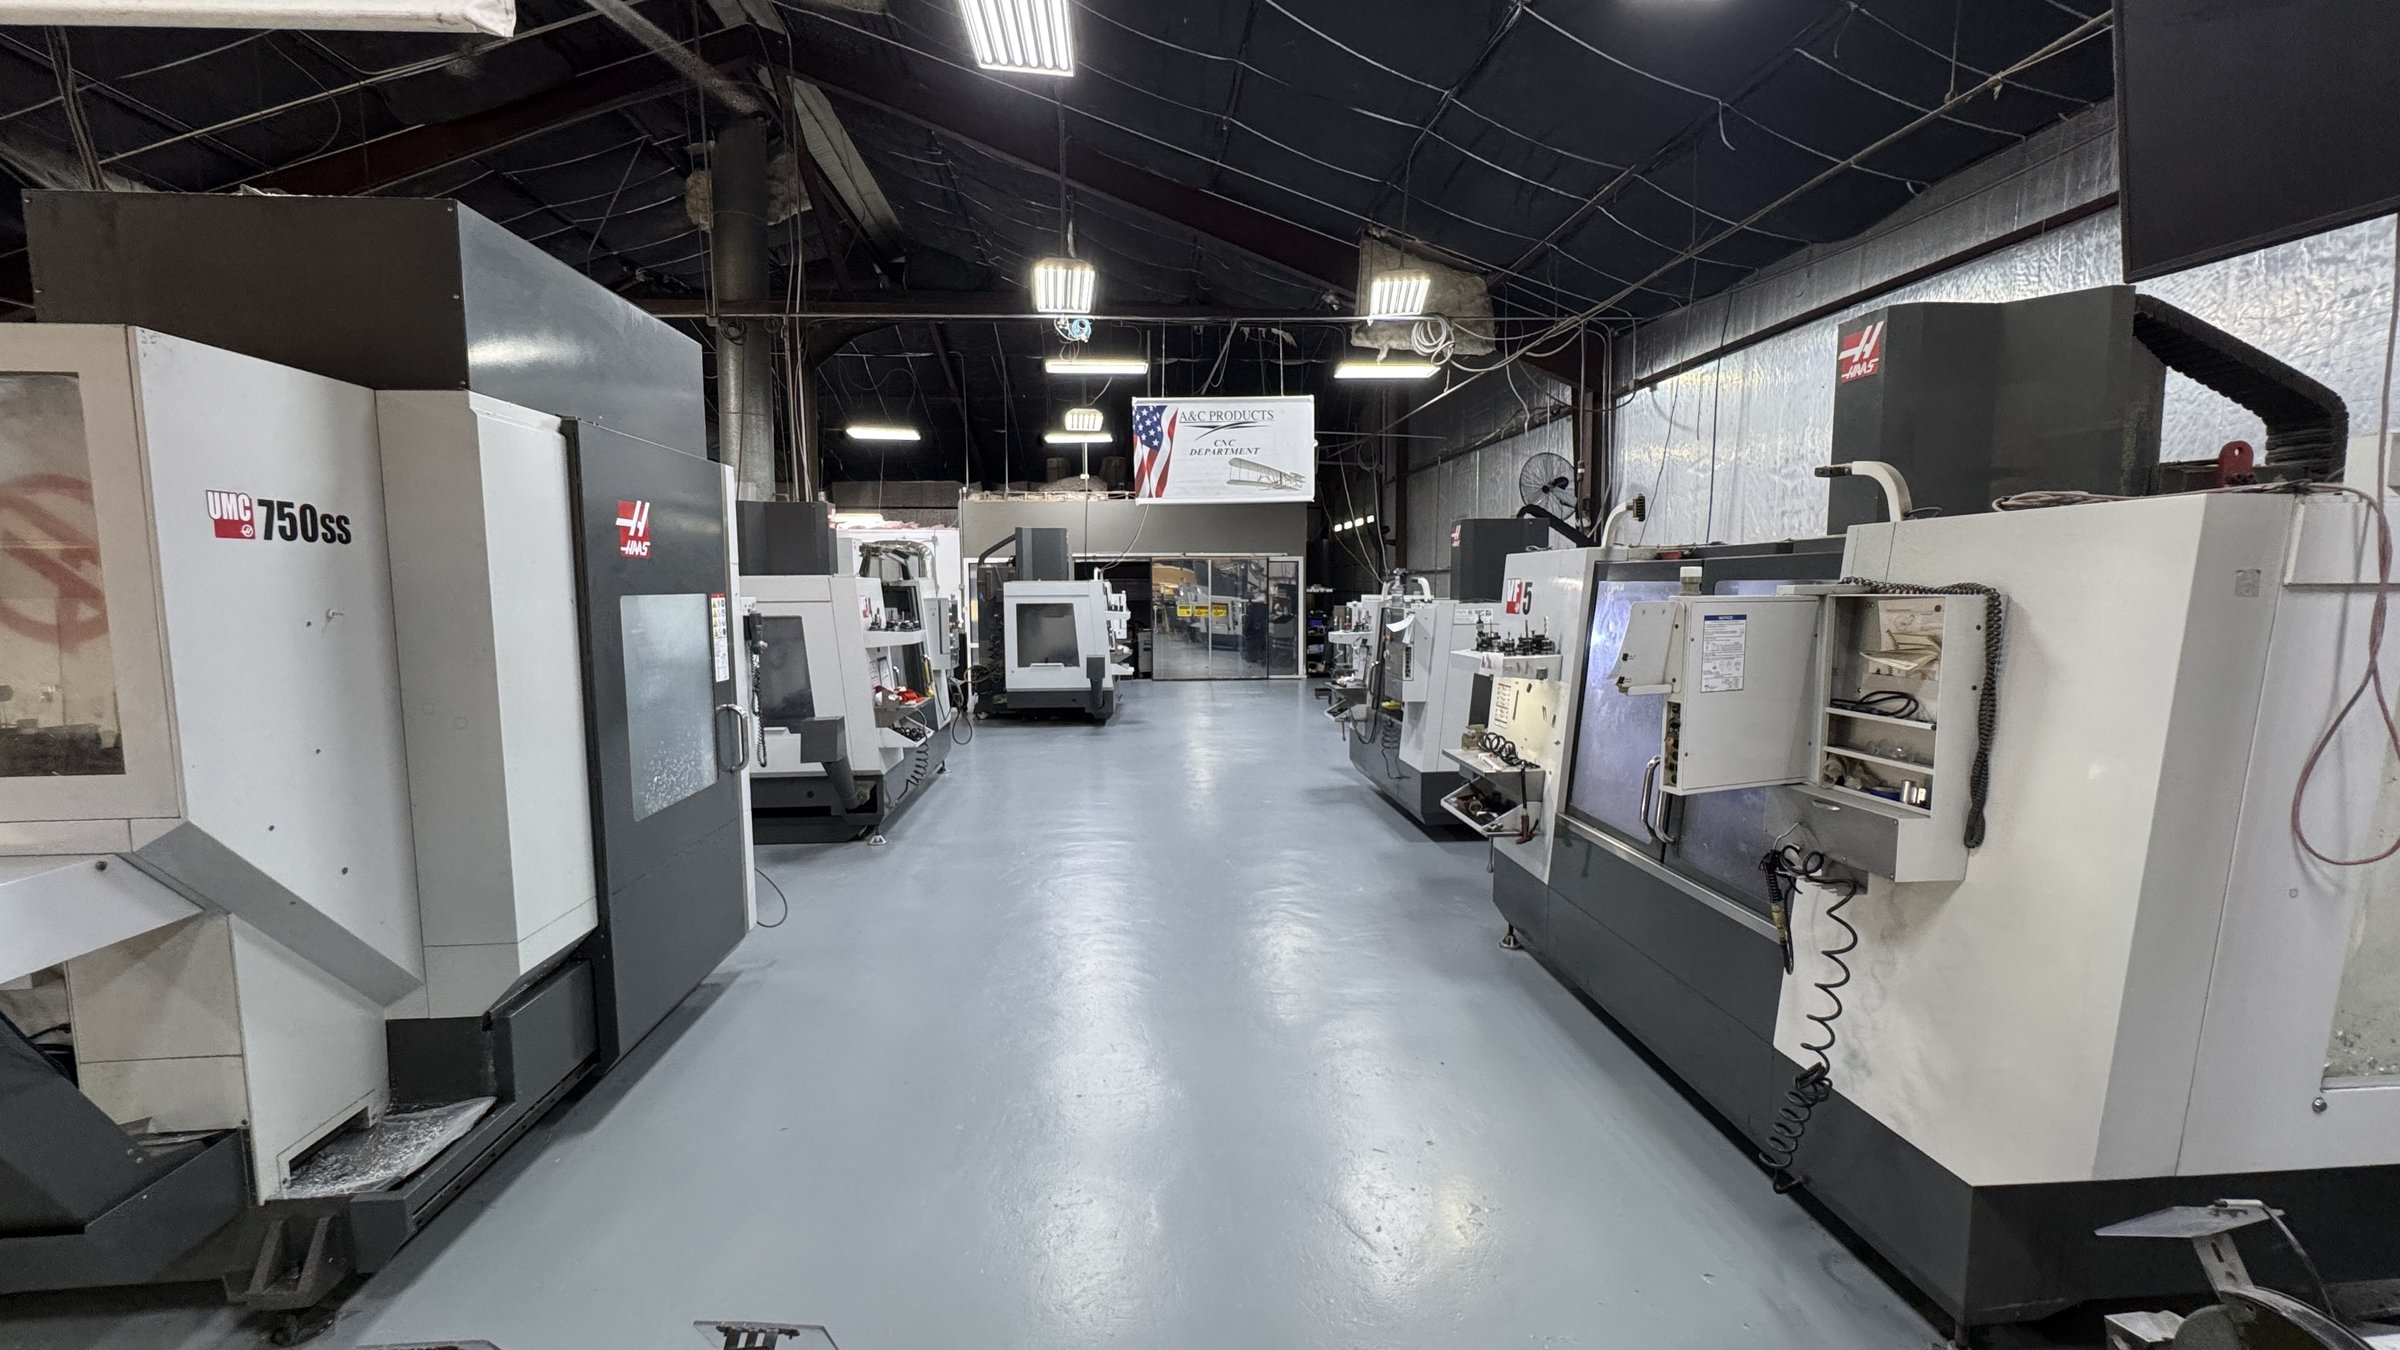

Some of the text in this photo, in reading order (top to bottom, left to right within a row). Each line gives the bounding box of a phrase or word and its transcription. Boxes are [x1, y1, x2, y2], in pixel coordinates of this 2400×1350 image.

[1841, 357, 1880, 380] HAAS
[1179, 409, 1274, 421] A&C PRODUCTS
[1189, 447, 1260, 456] DEPARTMENT
[1214, 439, 1236, 447] CNC
[206, 490, 251, 522] UMC
[620, 539, 651, 557] HAAS
[1522, 581, 1533, 615] 5
